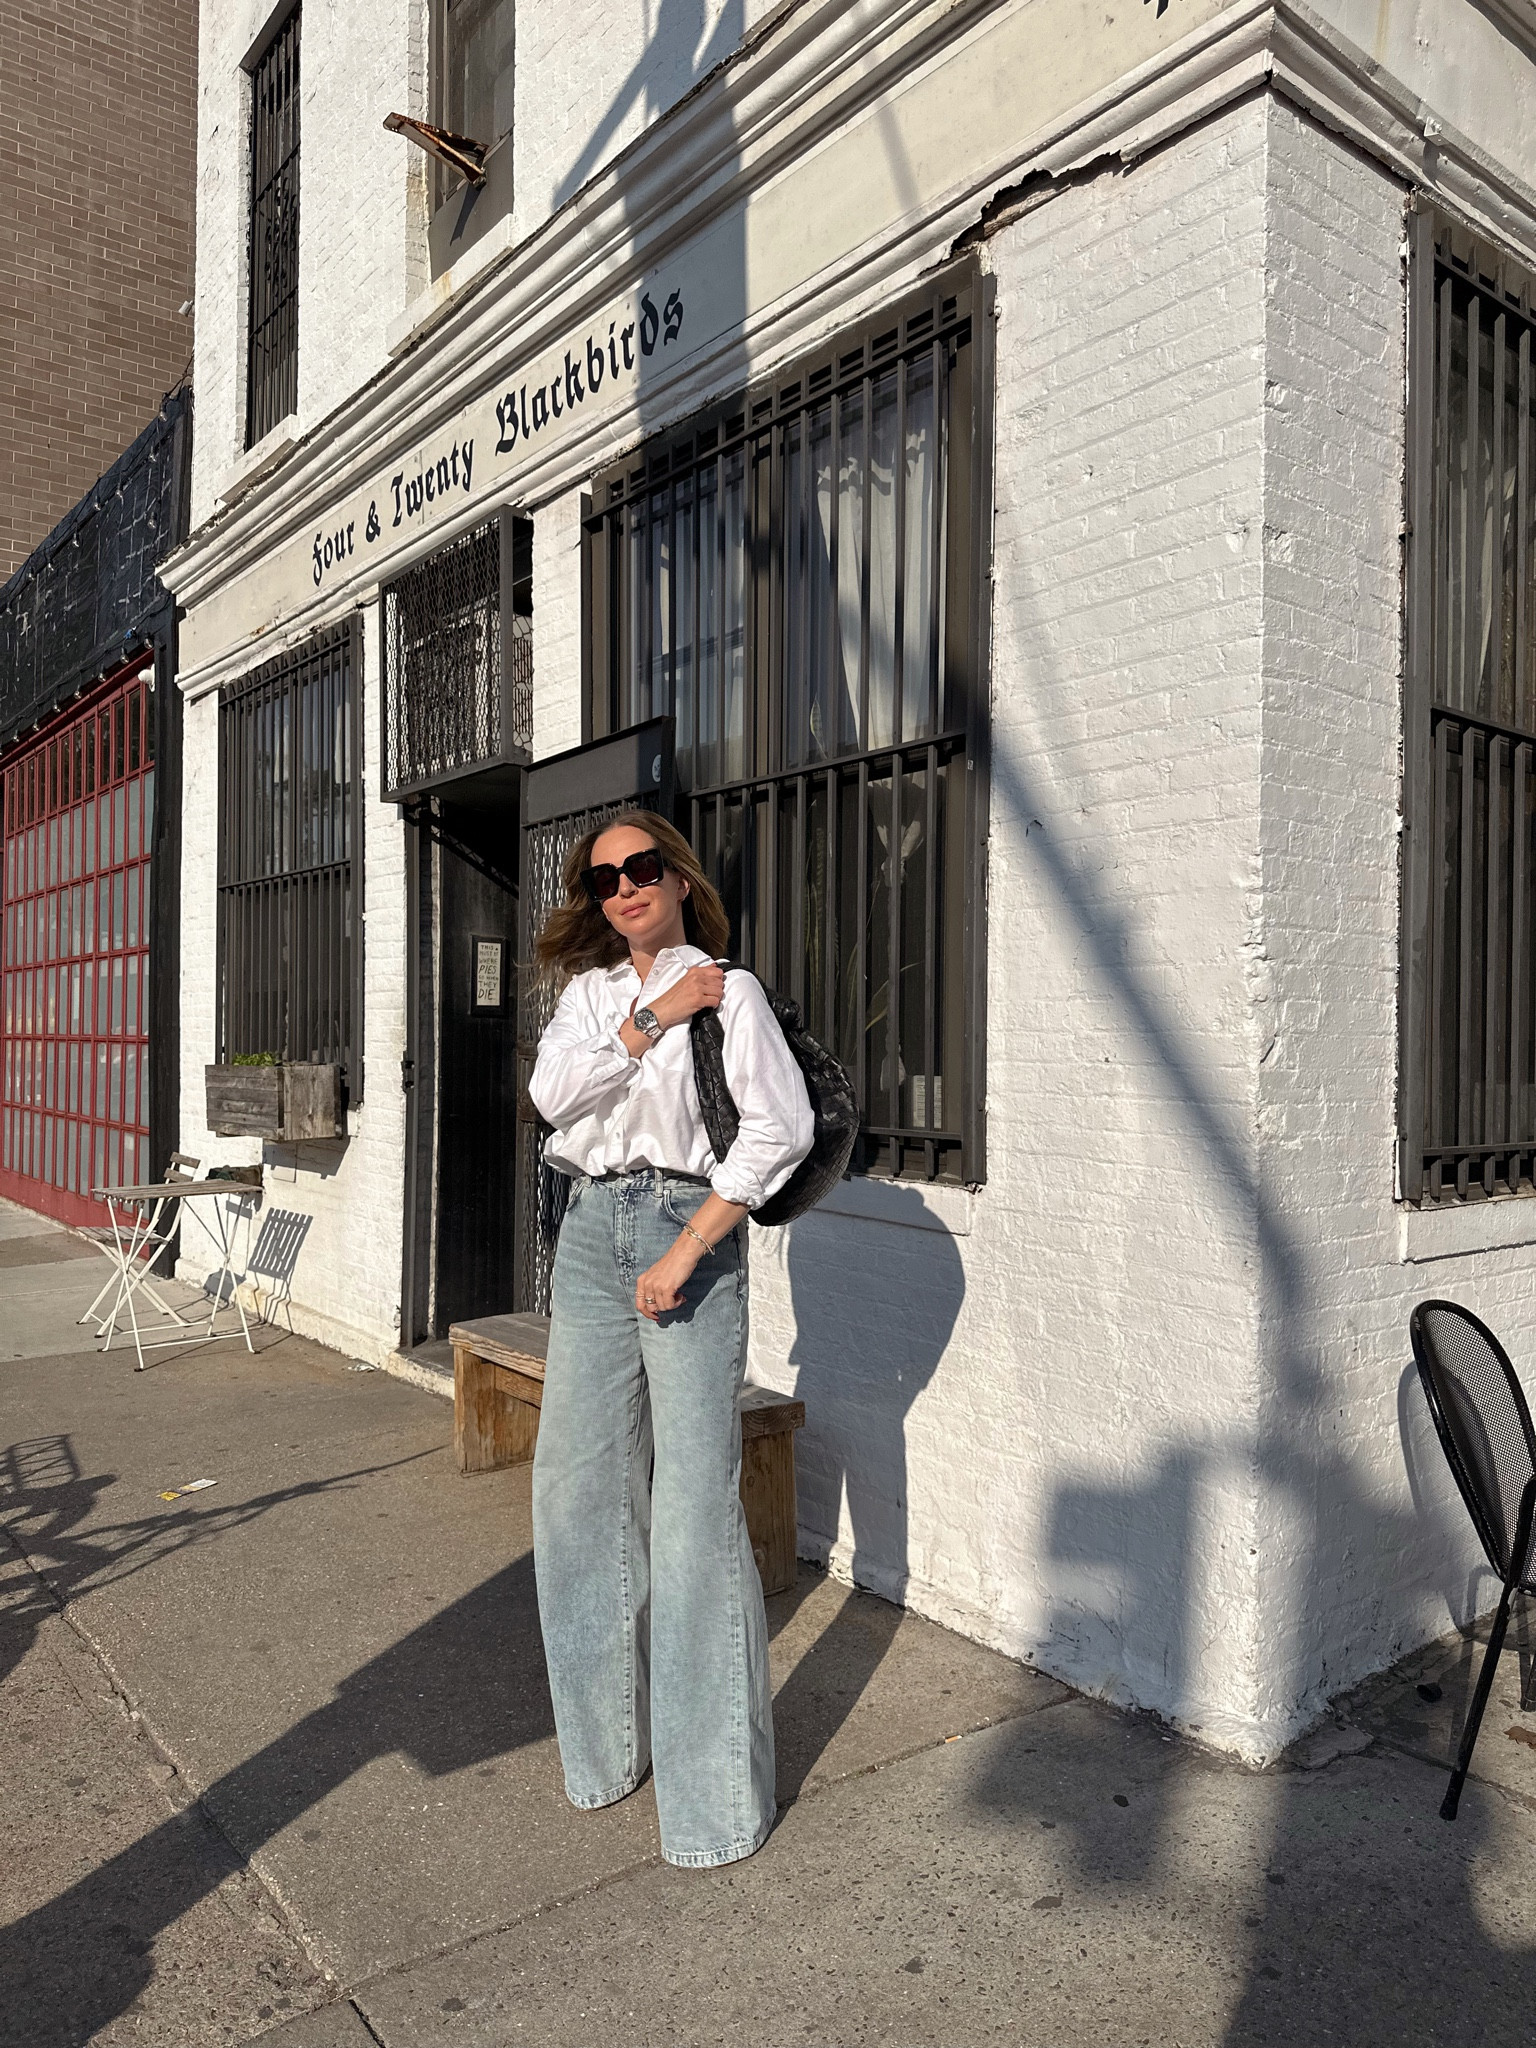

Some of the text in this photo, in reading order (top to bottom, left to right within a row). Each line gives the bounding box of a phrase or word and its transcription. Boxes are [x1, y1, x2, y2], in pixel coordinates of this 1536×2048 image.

[365, 499, 381, 544] &
[390, 438, 474, 528] Twenty
[495, 287, 684, 456] Blackbirds
[478, 964, 497, 974] PIES
[478, 980, 497, 988] THEY
[478, 988, 496, 1000] DIE
